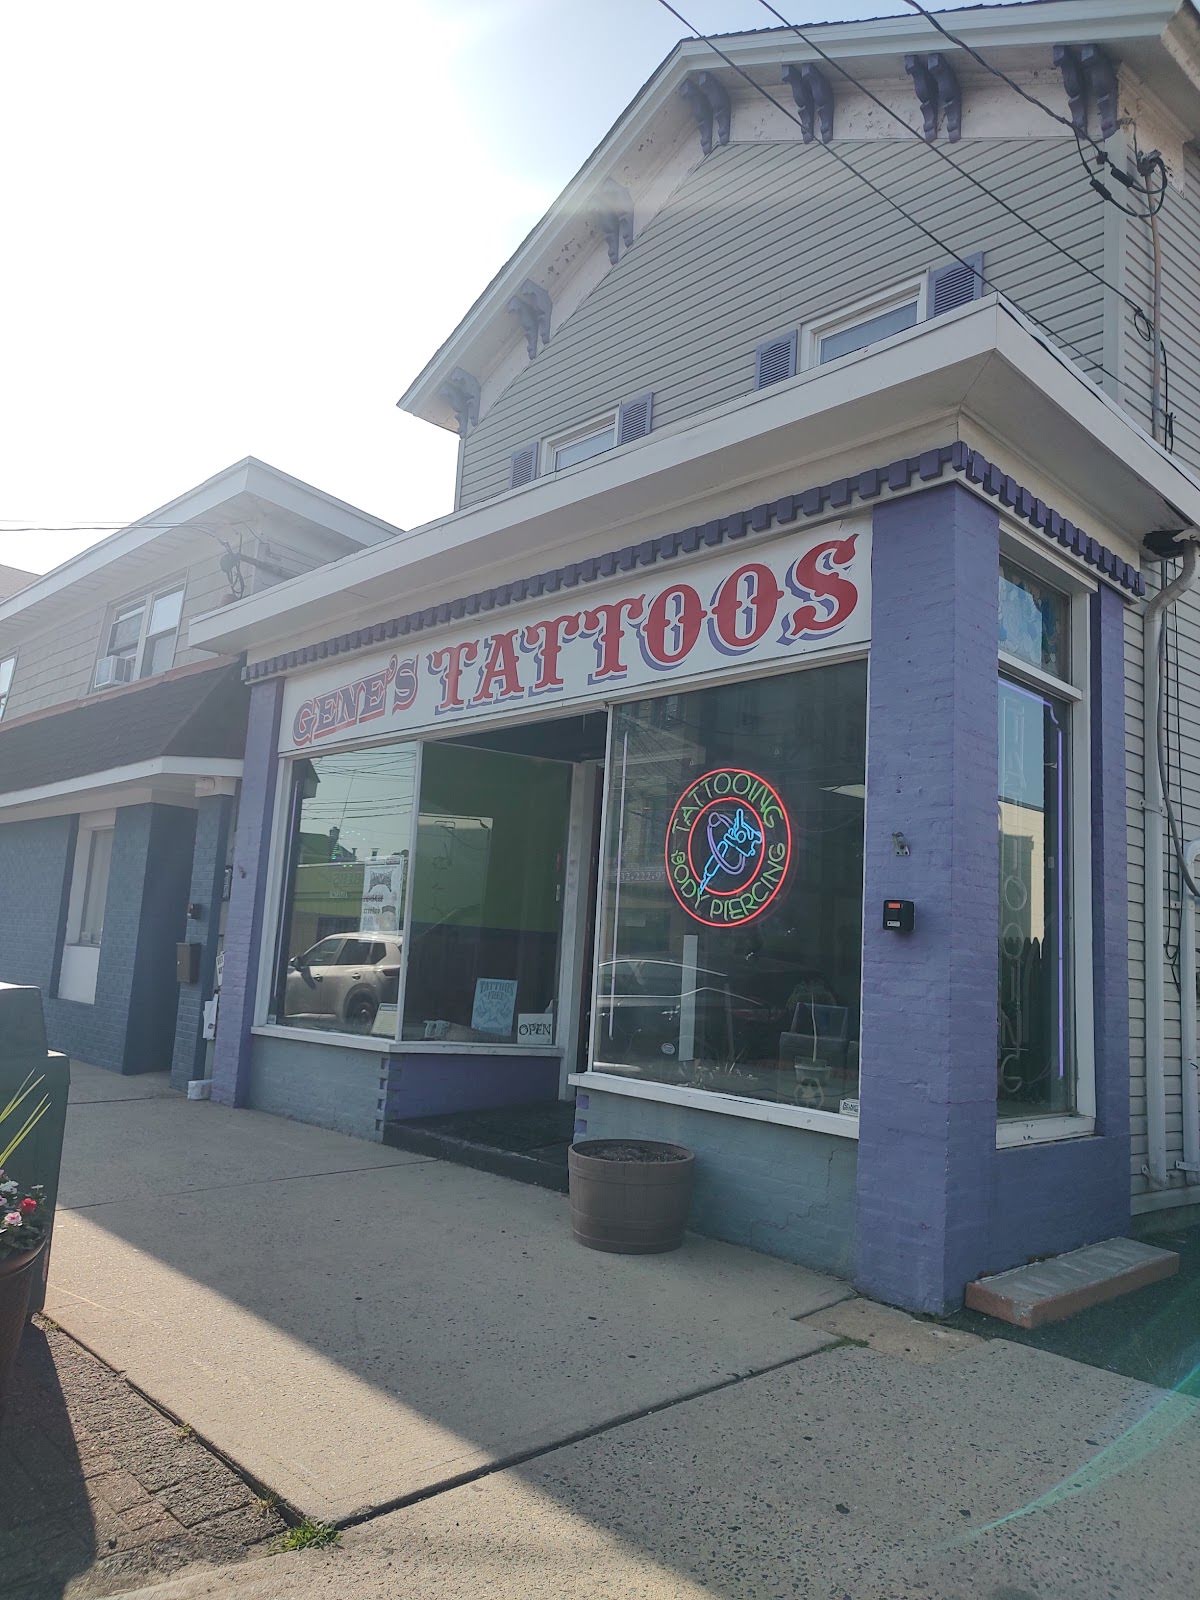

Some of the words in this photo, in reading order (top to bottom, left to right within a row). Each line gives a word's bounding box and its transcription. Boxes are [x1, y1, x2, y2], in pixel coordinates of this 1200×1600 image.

[292, 653, 419, 747] GENE'S
[427, 533, 859, 716] TATTOOS
[671, 773, 785, 835] TATTOOING
[709, 843, 786, 922] PIERCING
[518, 1023, 552, 1036] OPEN
